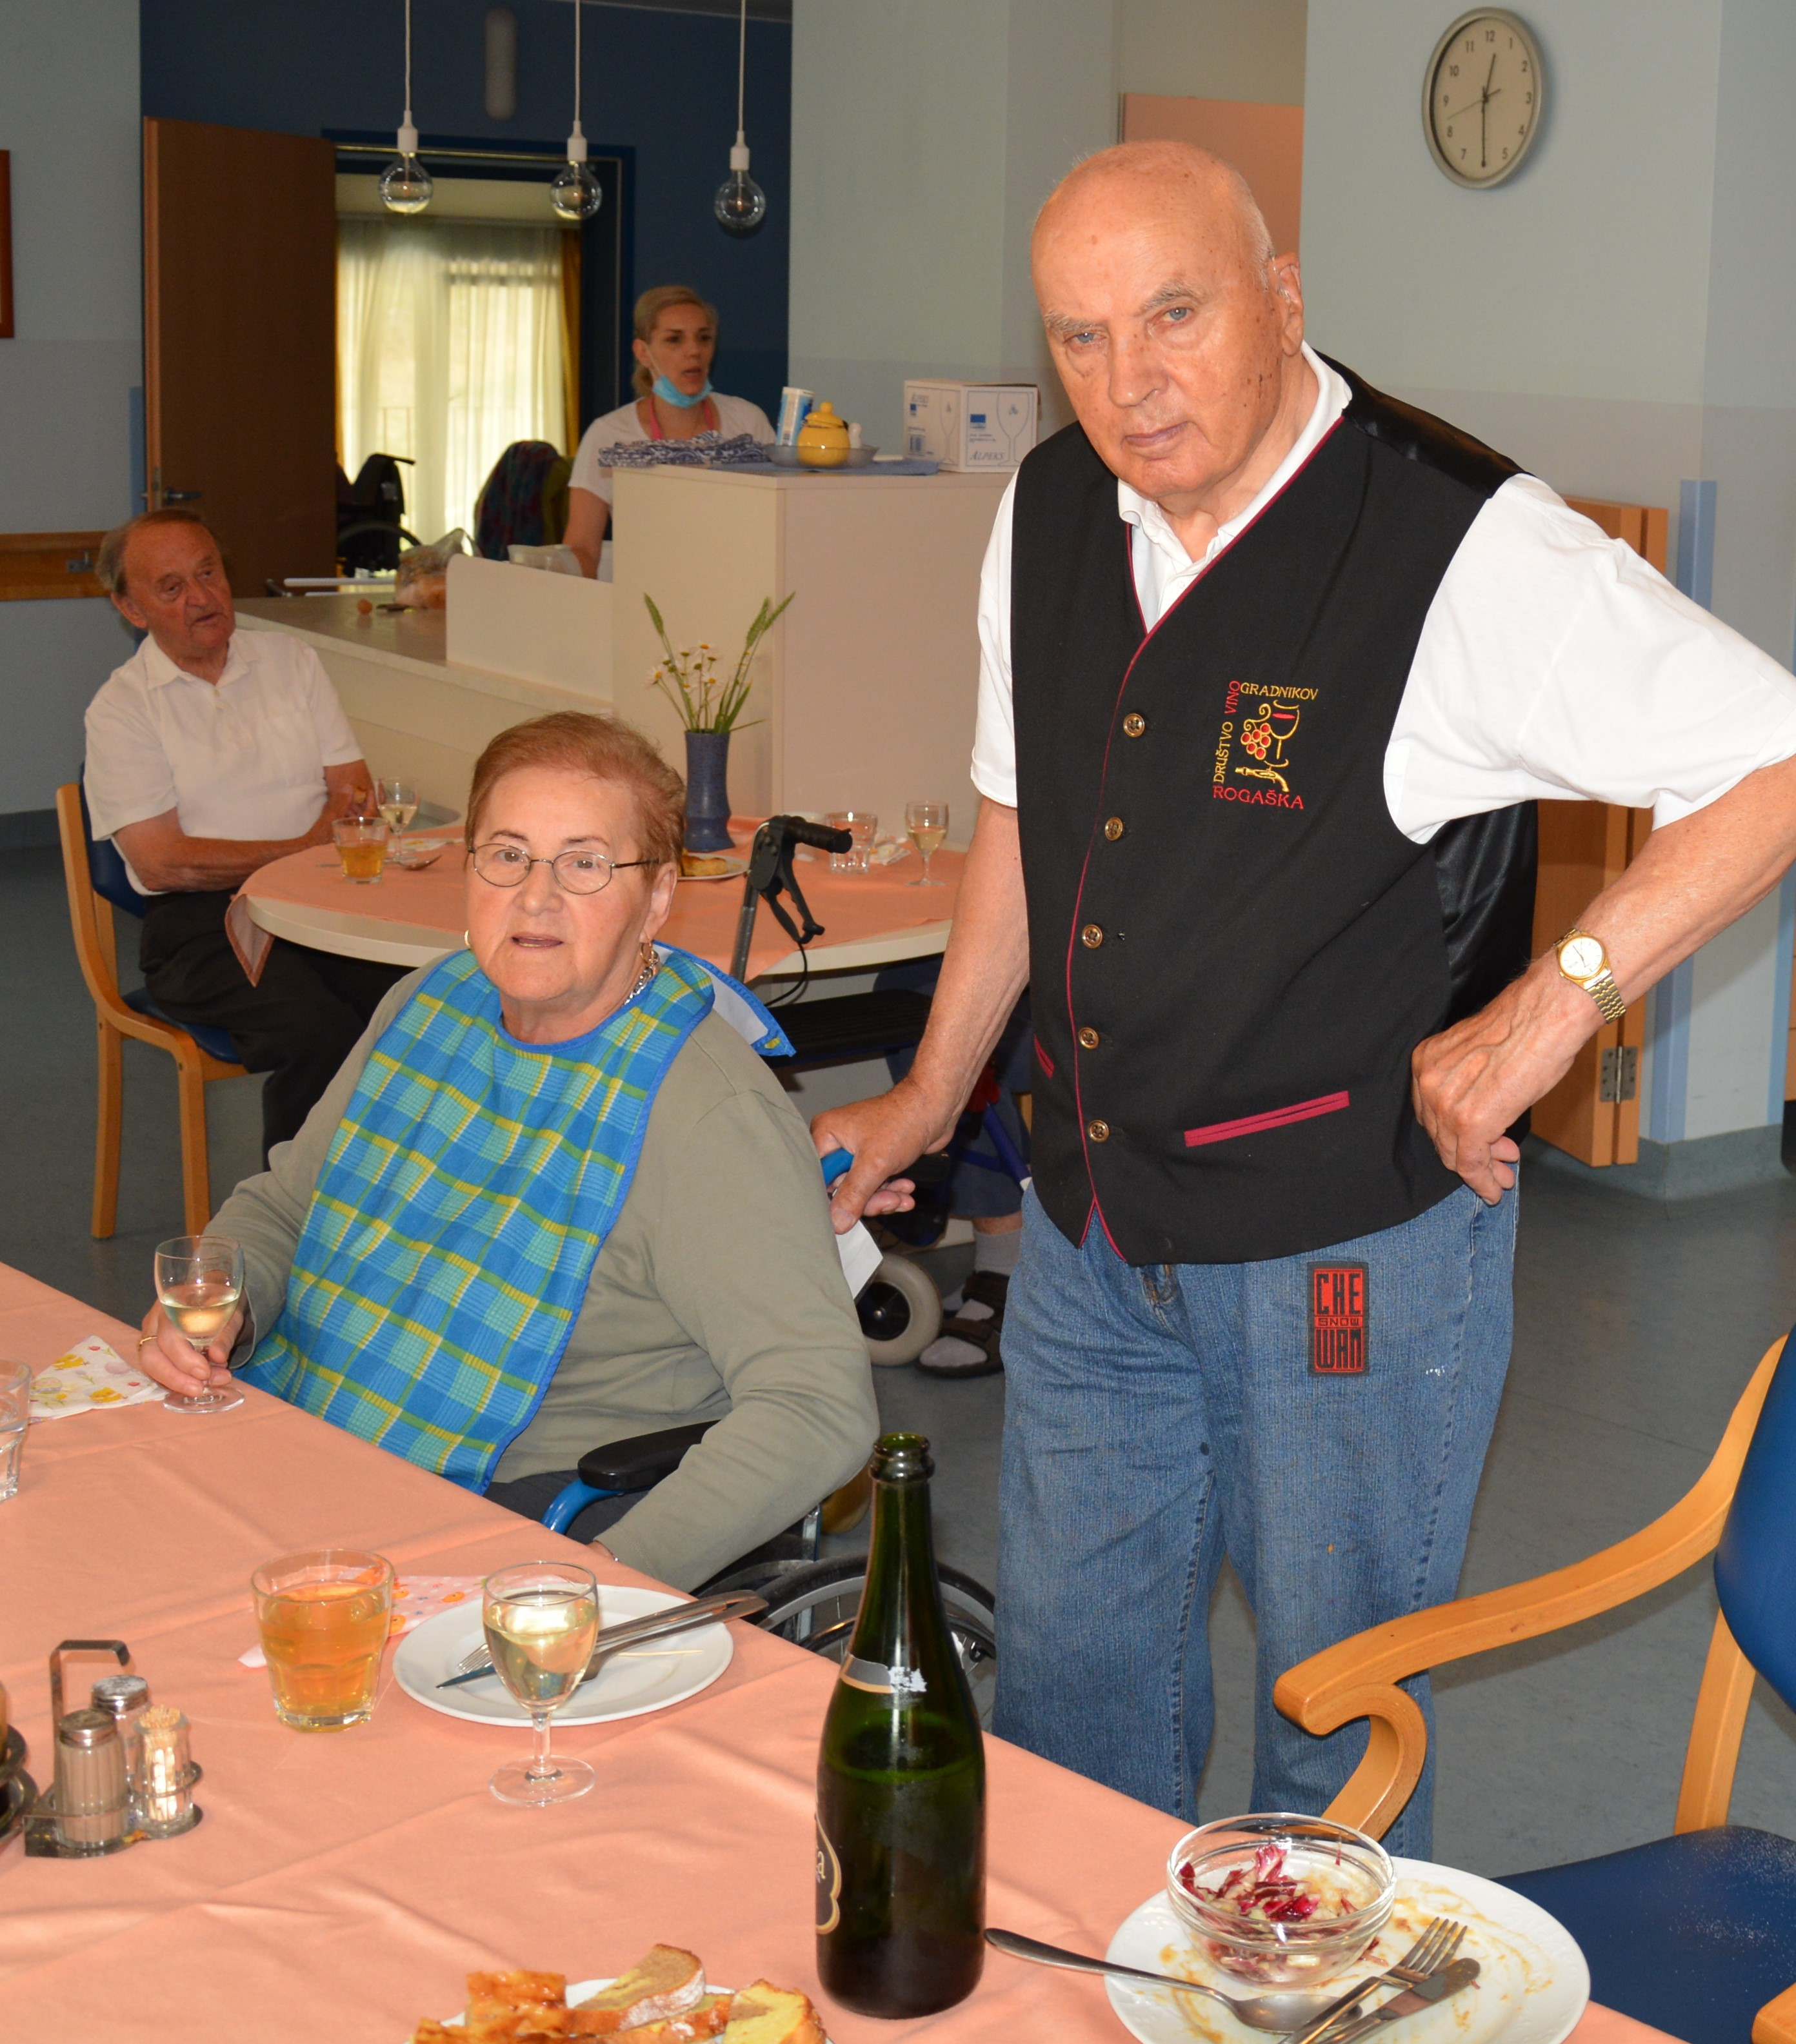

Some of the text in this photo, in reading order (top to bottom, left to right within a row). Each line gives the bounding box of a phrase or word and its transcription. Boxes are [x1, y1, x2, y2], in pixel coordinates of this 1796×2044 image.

[1486, 30, 1495, 42] 12
[1466, 41, 1474, 52] 11
[1509, 37, 1513, 50] 1
[1450, 65, 1459, 76] 10
[1522, 60, 1528, 72] 2
[1443, 95, 1449, 106] 9
[1526, 92, 1532, 104] 3
[1448, 126, 1453, 137] 8
[1518, 124, 1524, 135] 4
[1461, 148, 1466, 160] 7
[1502, 148, 1508, 159] 5
[1213, 680, 1319, 784] DRUŠTVO VINO GRADNIKOV
[1213, 785, 1304, 809] ROGAŠKA
[1316, 1273, 1361, 1315] CHE
[1318, 1318, 1359, 1326] SNOW
